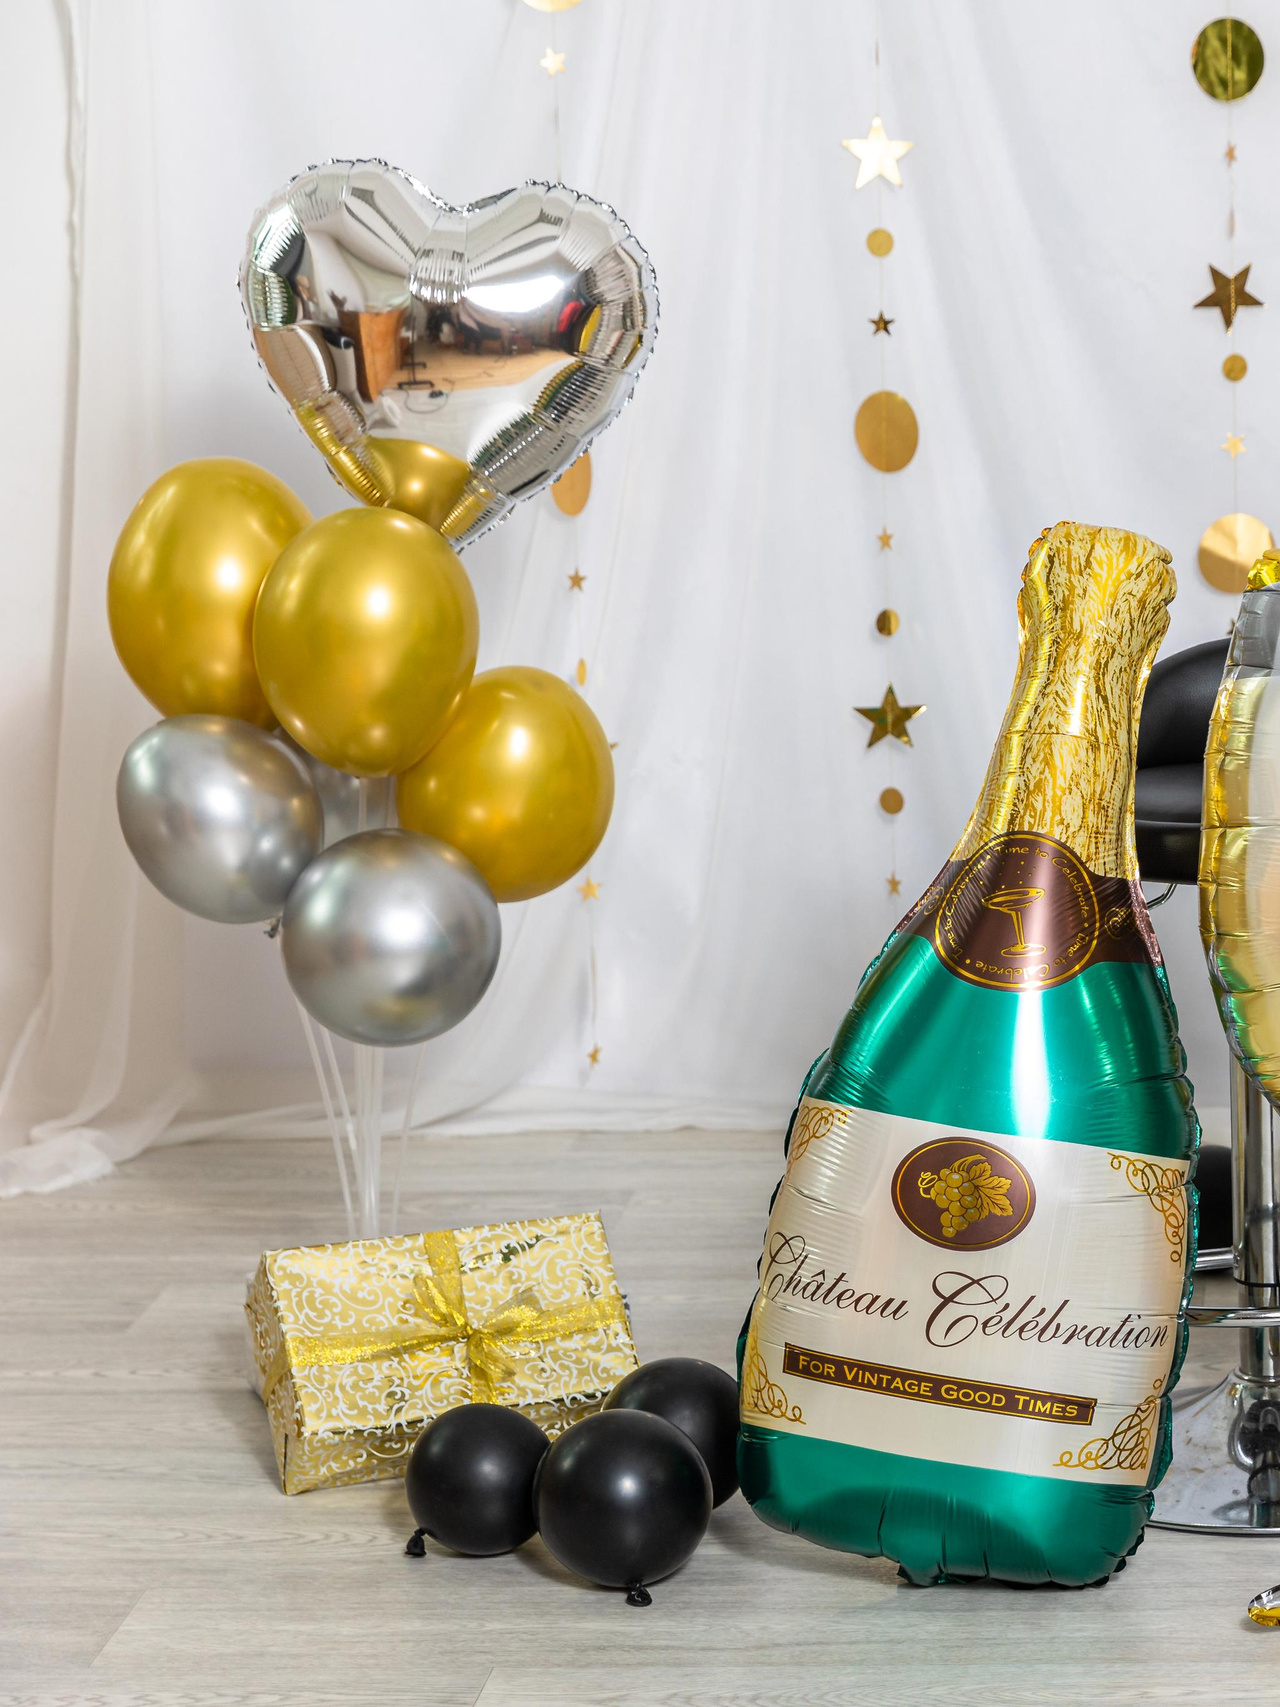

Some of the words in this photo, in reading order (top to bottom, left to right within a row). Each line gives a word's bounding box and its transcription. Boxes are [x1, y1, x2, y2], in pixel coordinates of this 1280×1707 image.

[1034, 847, 1049, 858] to
[1051, 857, 1090, 919] Celebrate
[1053, 956, 1067, 967] to
[762, 1231, 909, 1321] Château
[925, 1270, 1169, 1349] Célébration
[799, 1354, 836, 1378] FOR
[843, 1364, 933, 1396] VINTAGE
[940, 1383, 1006, 1408] GOOD
[1014, 1394, 1079, 1417] TIMES
